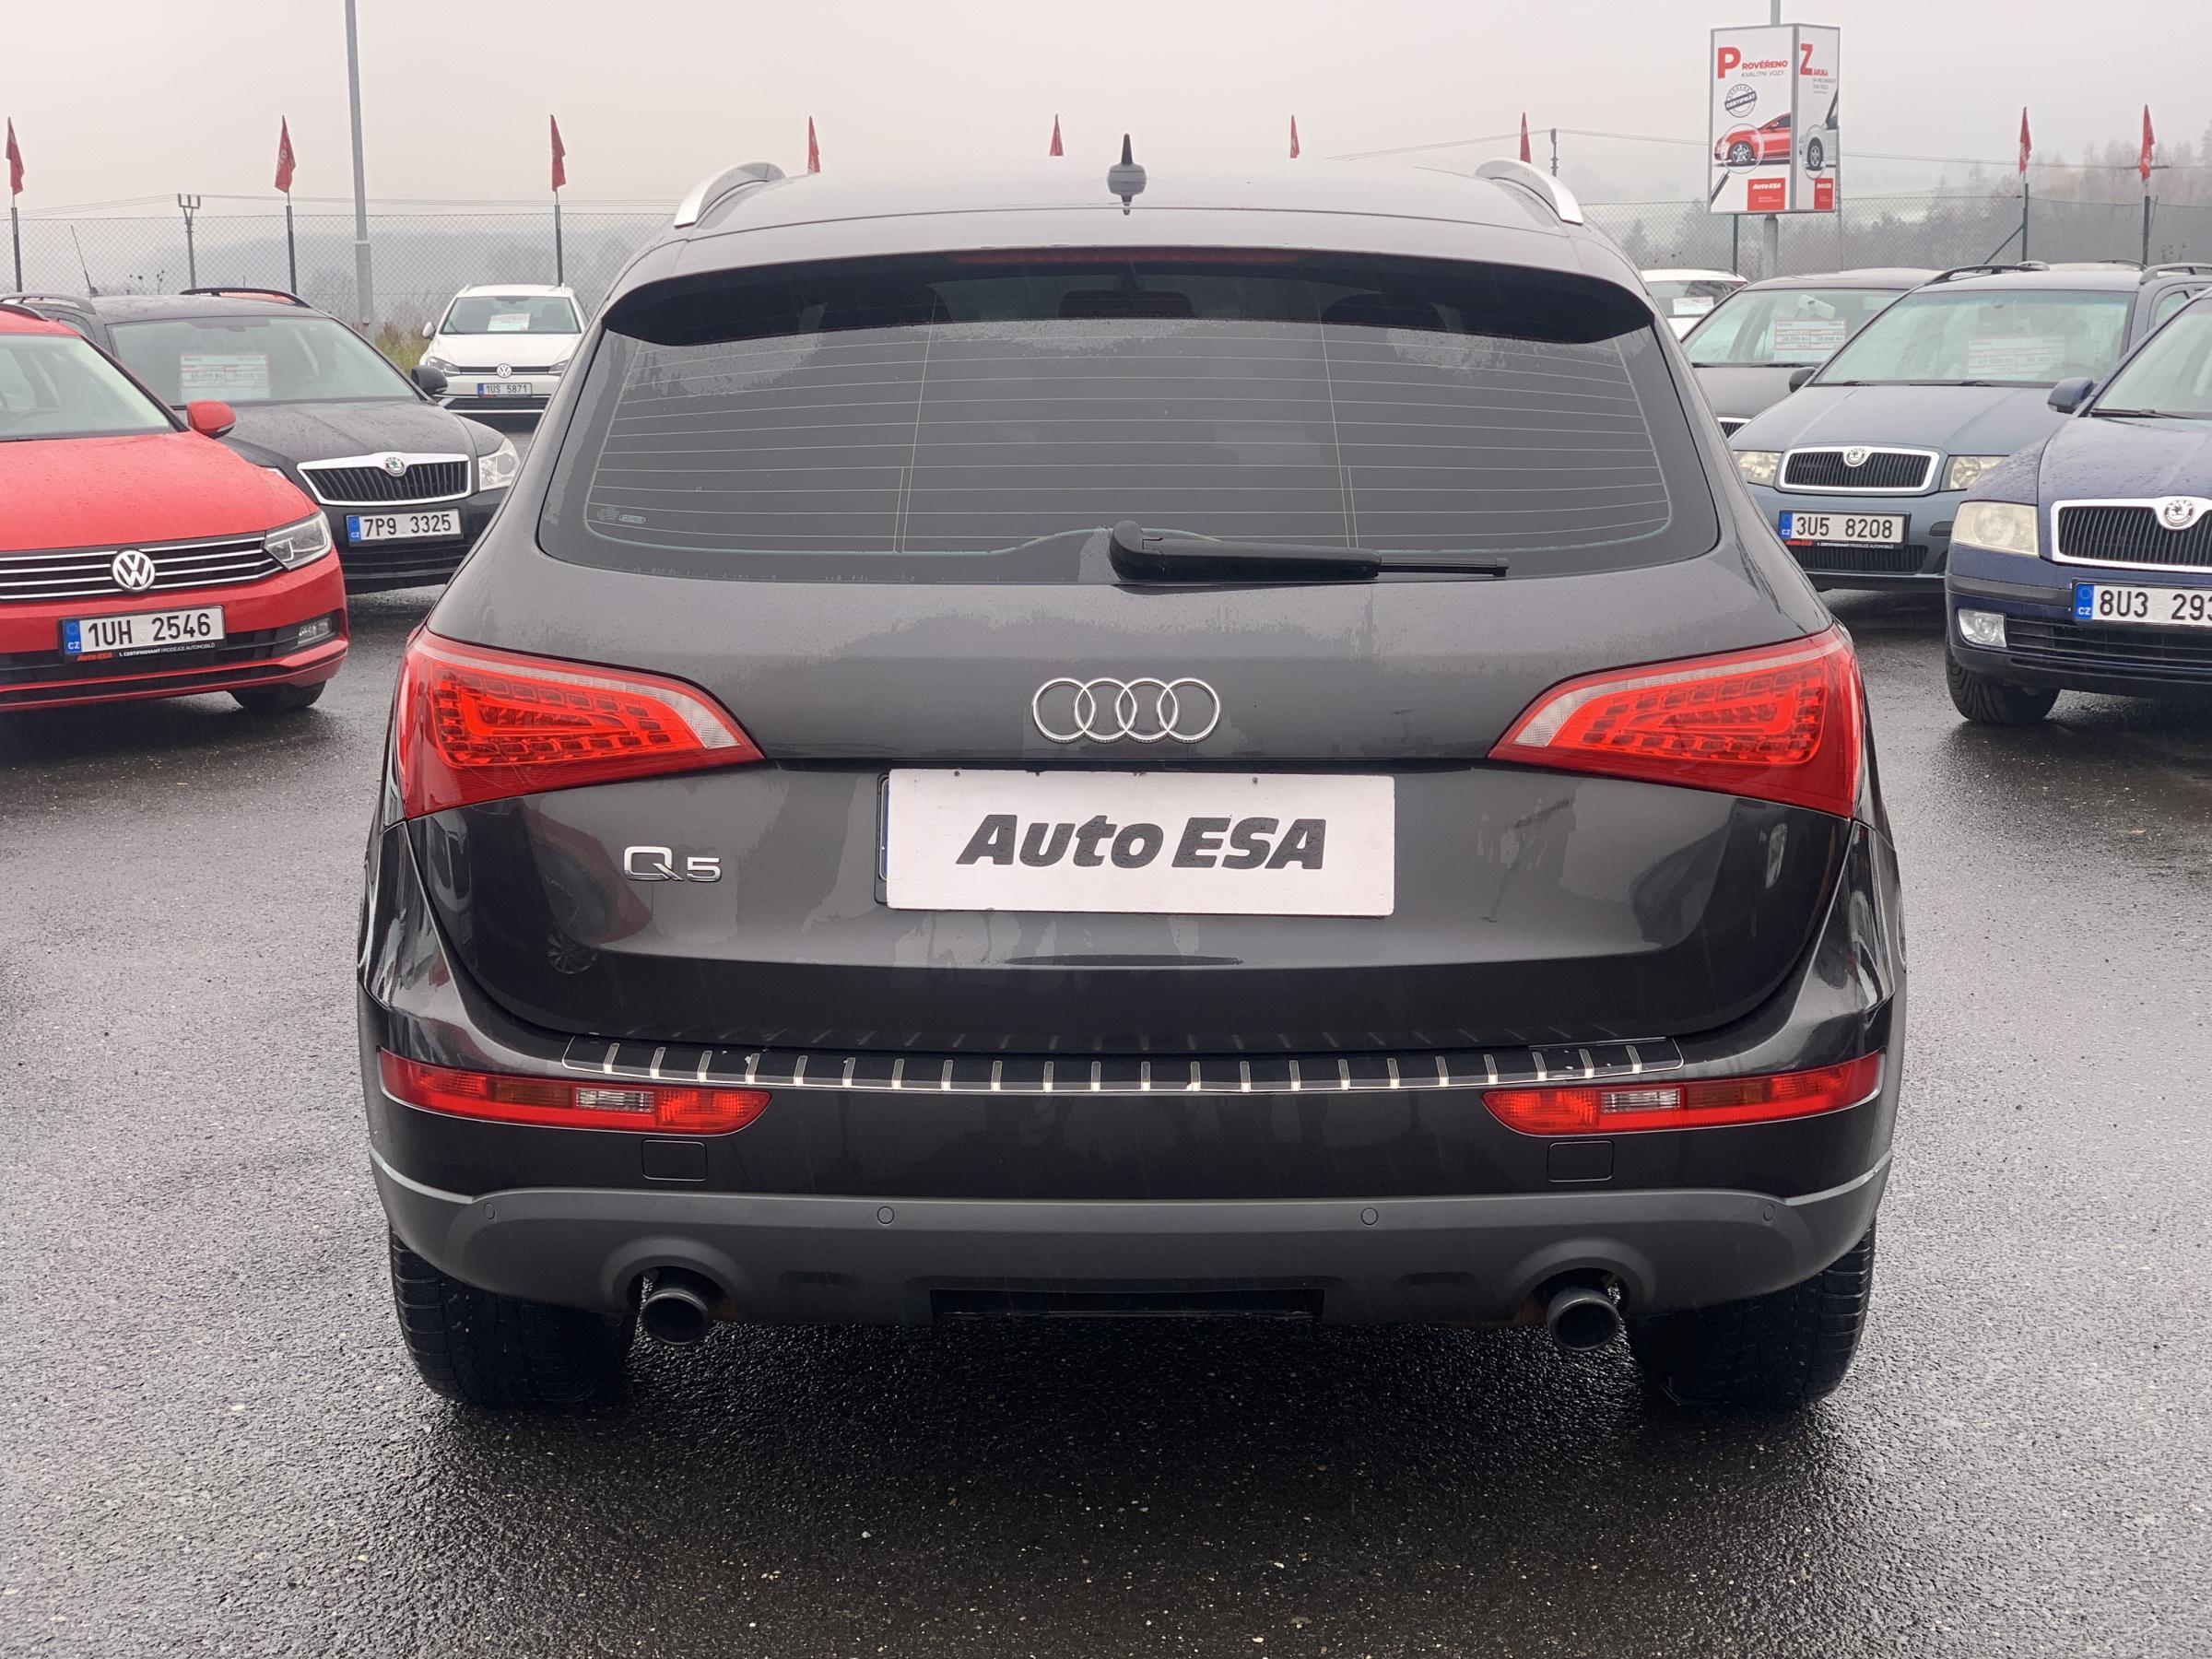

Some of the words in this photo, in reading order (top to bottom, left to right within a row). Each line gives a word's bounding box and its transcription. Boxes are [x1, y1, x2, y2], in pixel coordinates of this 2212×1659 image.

[486, 384, 500, 394] 1US
[506, 384, 527, 394] 5871
[364, 517, 397, 537] 7P9
[410, 513, 452, 534] 3325
[1796, 516, 1830, 536] 3U5
[1845, 518, 1893, 538] 8208
[2078, 607, 2091, 616] CZ
[2100, 590, 2148, 618] 8U3
[68, 641, 80, 650] CZ
[88, 619, 133, 647] 1UH
[151, 612, 211, 641] 2546
[185, 642, 216, 651] AUTOMOBILŮ
[955, 814, 1164, 869] Auto
[1171, 817, 1326, 870] ESA
[624, 846, 721, 882] Q5
